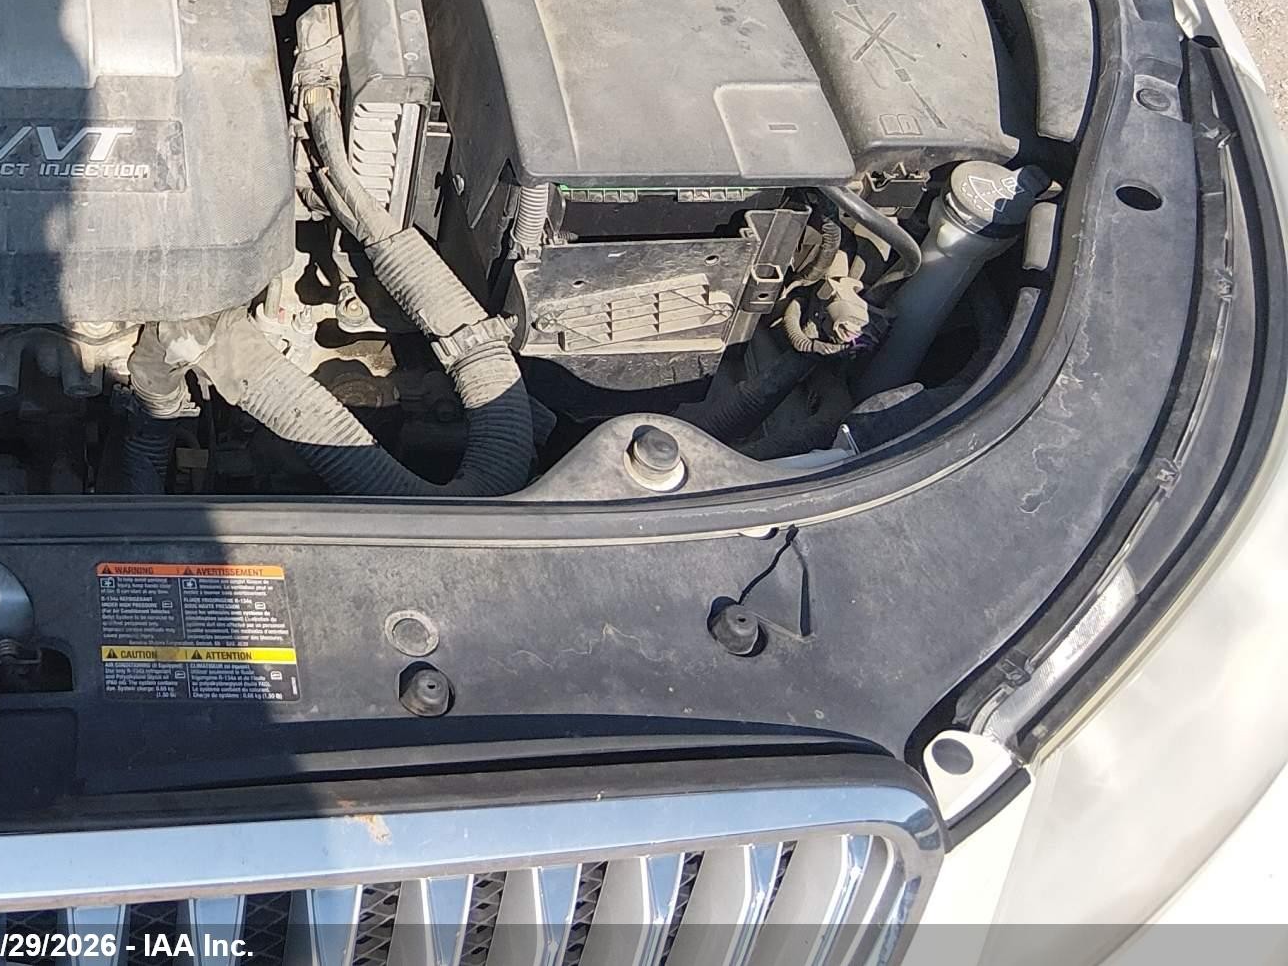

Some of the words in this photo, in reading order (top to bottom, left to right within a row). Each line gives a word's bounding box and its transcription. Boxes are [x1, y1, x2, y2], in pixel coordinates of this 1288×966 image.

[39, 162, 150, 179] INJECTION
[114, 566, 154, 575] WARNING
[196, 567, 264, 577] AVERTISSEMENT
[120, 650, 158, 659] CAUTION
[205, 650, 253, 661] ATTENTION
